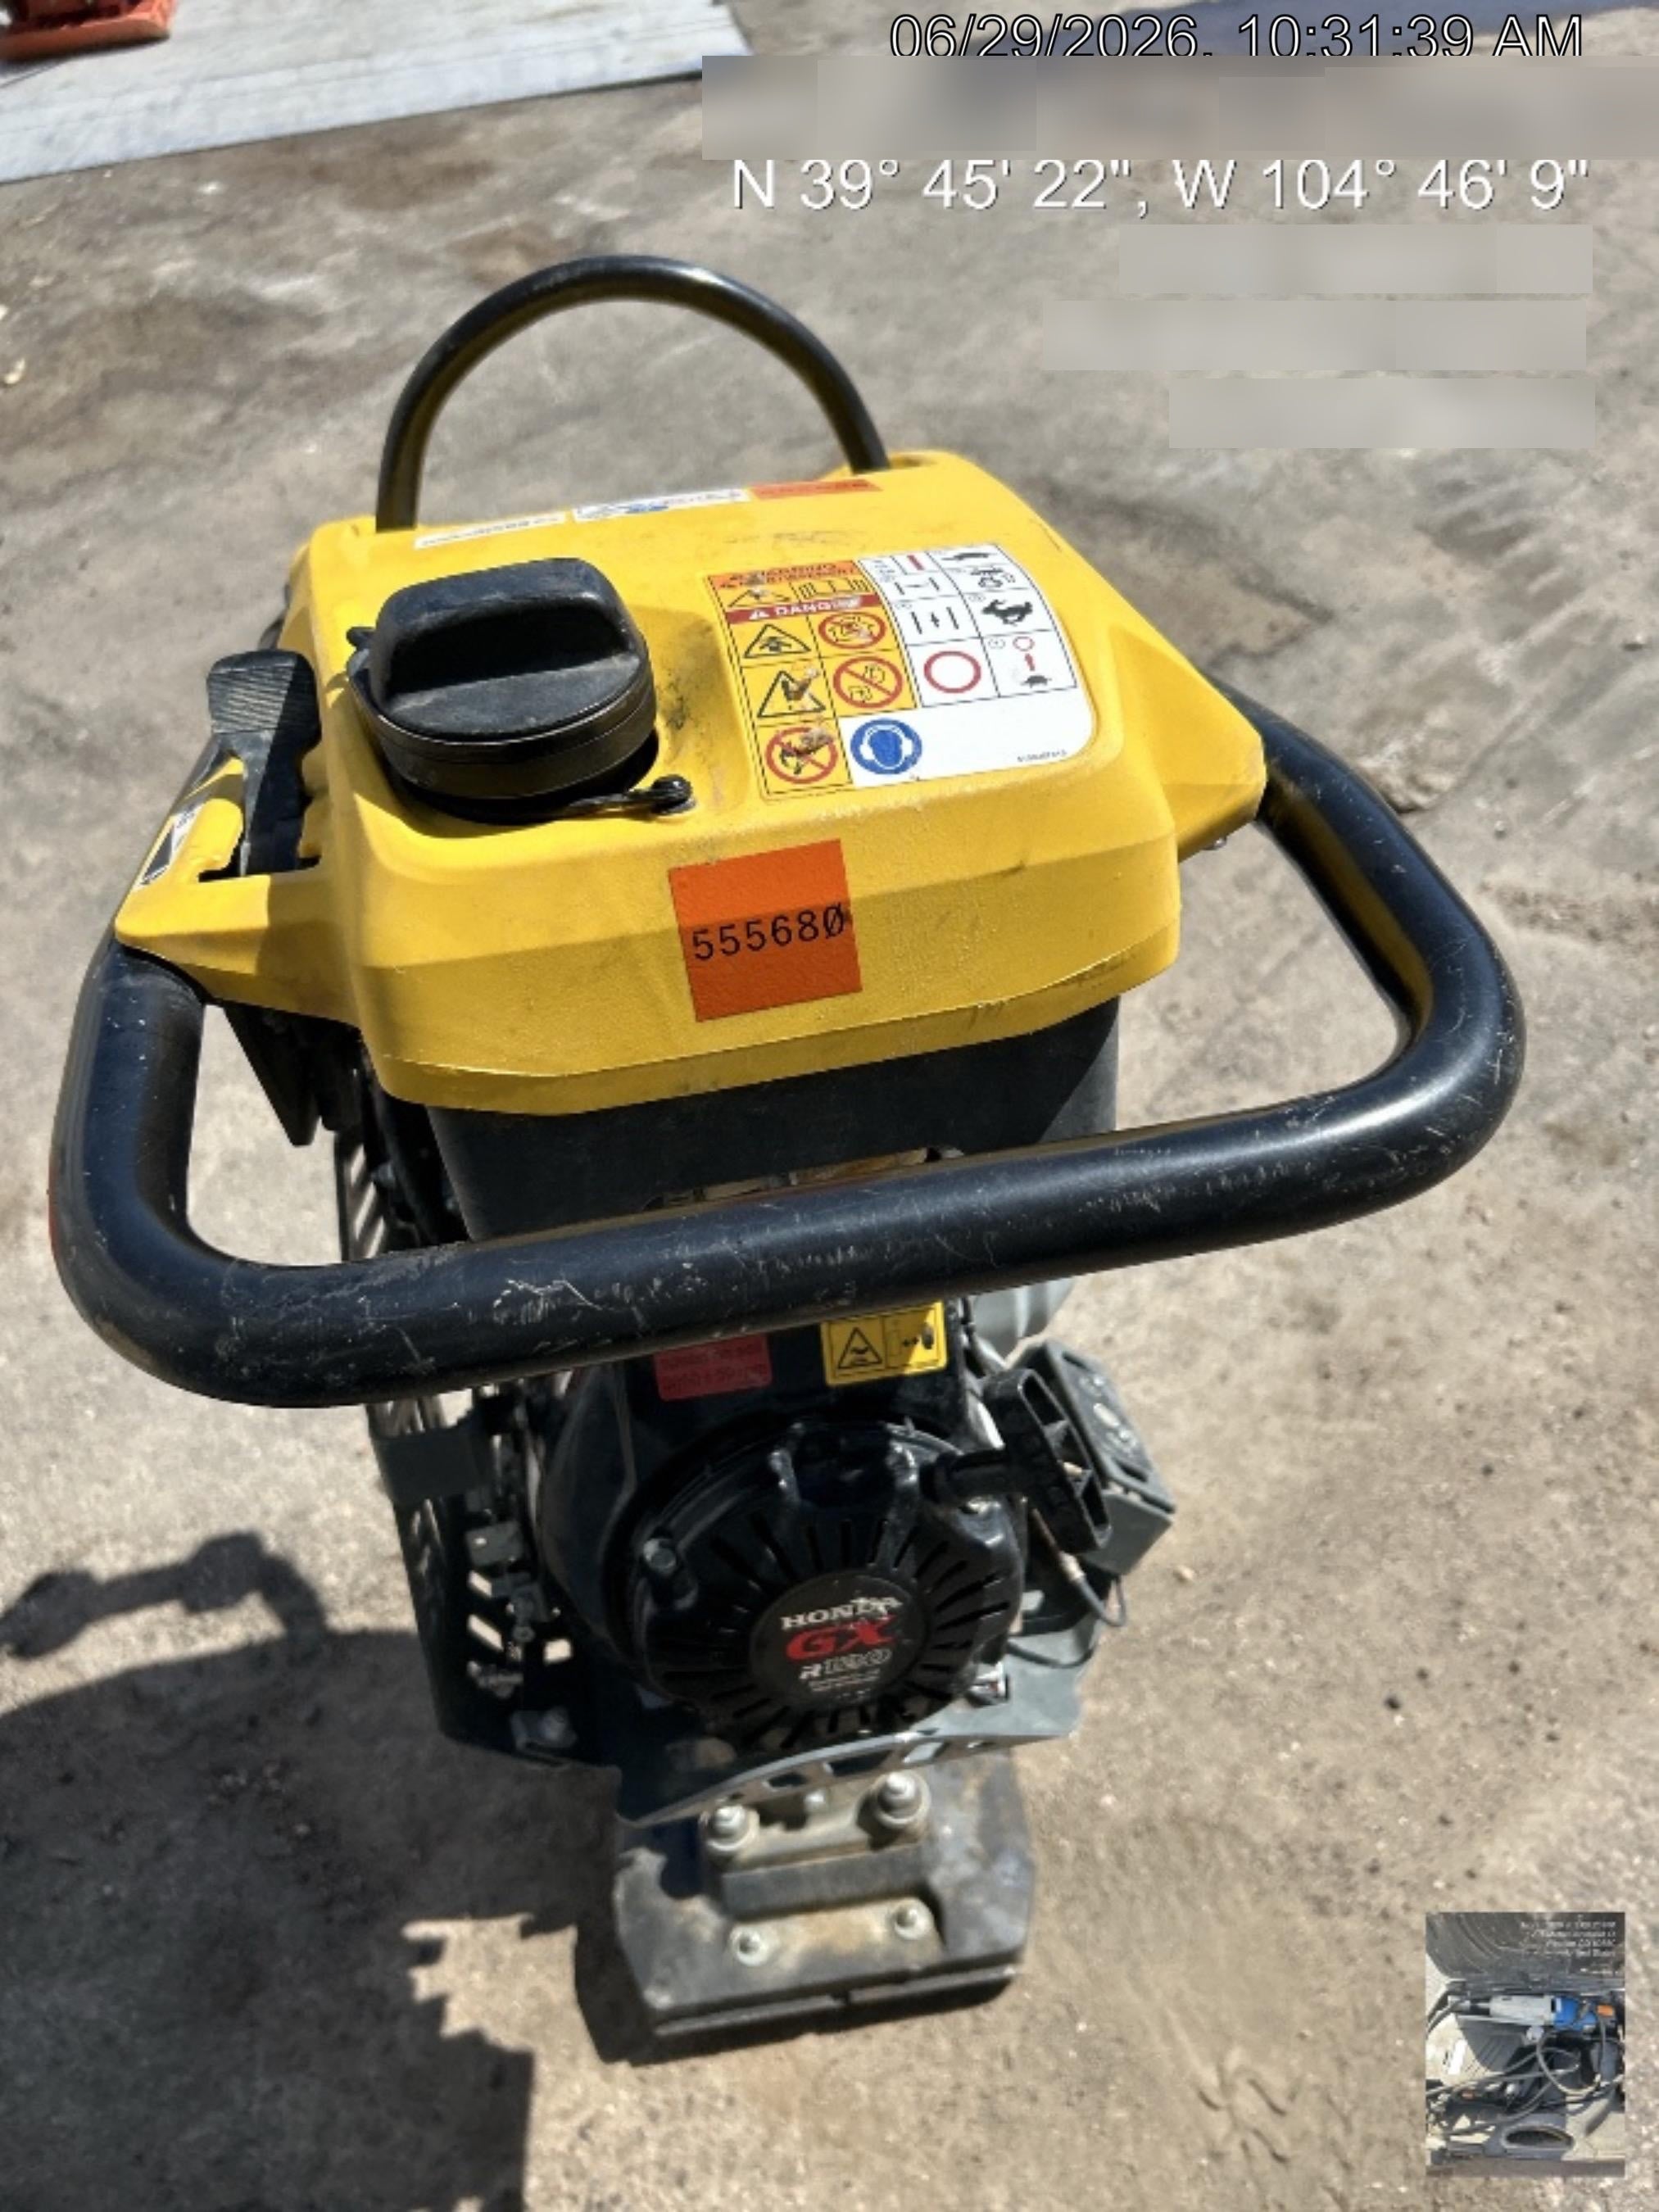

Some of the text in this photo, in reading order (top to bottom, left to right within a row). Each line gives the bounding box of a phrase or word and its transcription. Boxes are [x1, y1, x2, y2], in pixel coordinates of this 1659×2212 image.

[691, 902, 847, 962] 555680
[780, 1597, 904, 1631] HONDA
[786, 1614, 899, 1660] GX
